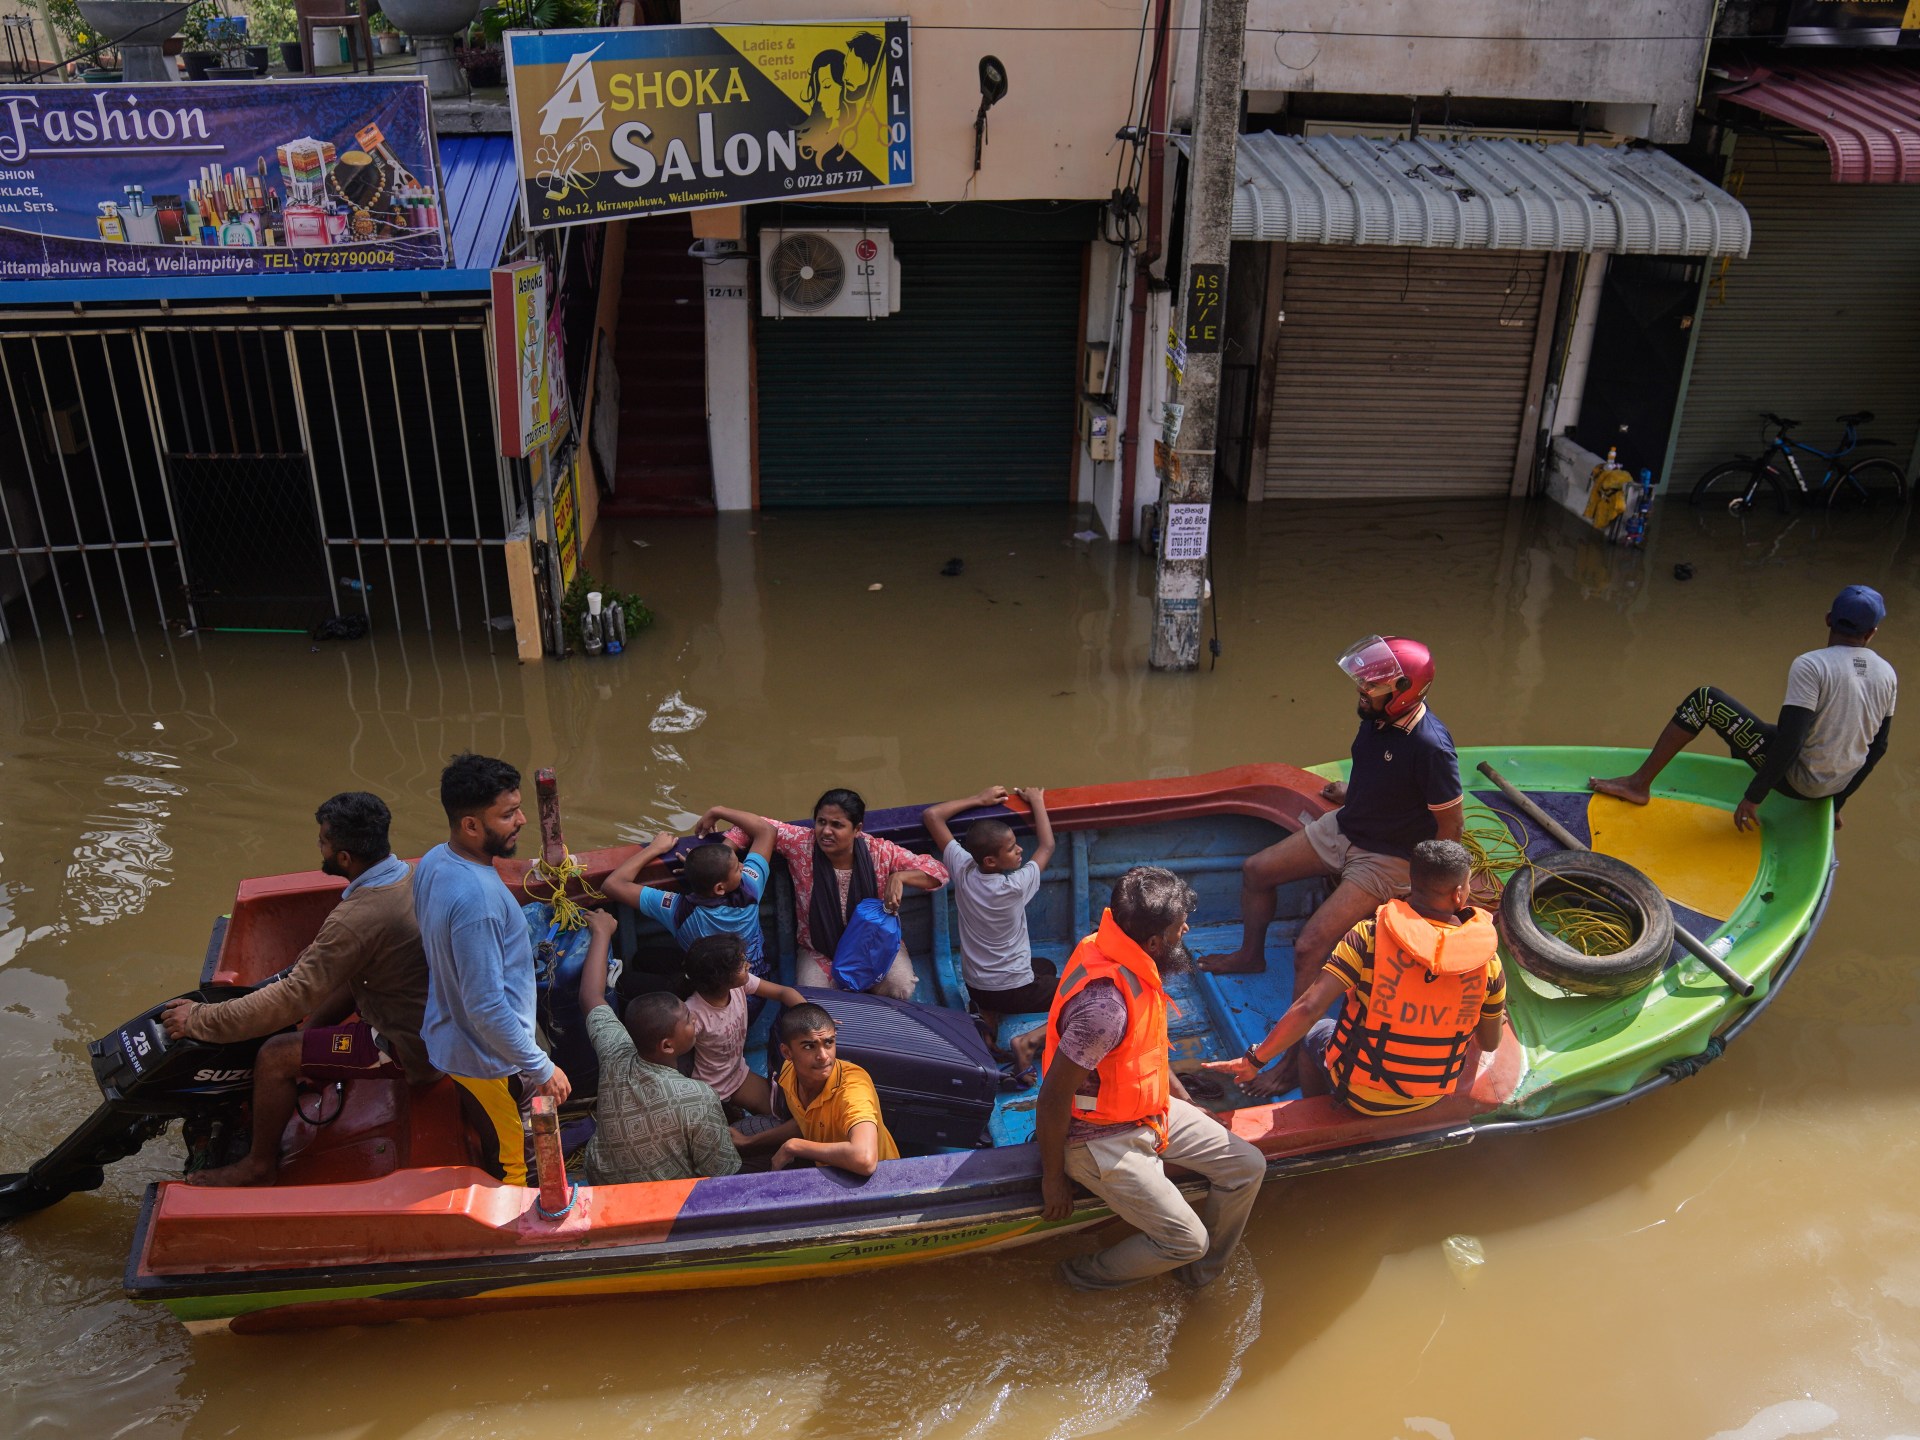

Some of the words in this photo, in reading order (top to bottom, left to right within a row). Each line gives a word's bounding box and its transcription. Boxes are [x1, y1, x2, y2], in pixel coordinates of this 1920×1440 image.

[742, 39, 783, 52] Ladies
[786, 38, 796, 49] &
[758, 54, 795, 66] Gents
[774, 69, 808, 81] Salon
[890, 36, 906, 172] SALON
[0, 91, 211, 163] Fashion
[797, 175, 823, 188] 0722
[826, 172, 844, 185] 875
[846, 169, 863, 183] 737
[0, 186, 43, 197] KLACE,
[557, 203, 593, 217] No.12,
[106, 258, 151, 274] Road,
[155, 254, 254, 273] Wellampitiya
[263, 253, 298, 269] TEL:
[303, 250, 395, 267] 0773790004
[857, 264, 875, 276] LG
[518, 274, 543, 295] Ashoka
[1195, 274, 1219, 289] AS
[709, 286, 743, 297] 12/1/1
[1195, 292, 1219, 306] 72
[1371, 948, 1416, 1019] POLIC
[1400, 1001, 1450, 1026] DIV.
[120, 1030, 143, 1074] KEROSENE
[132, 1031, 152, 1056] 25
